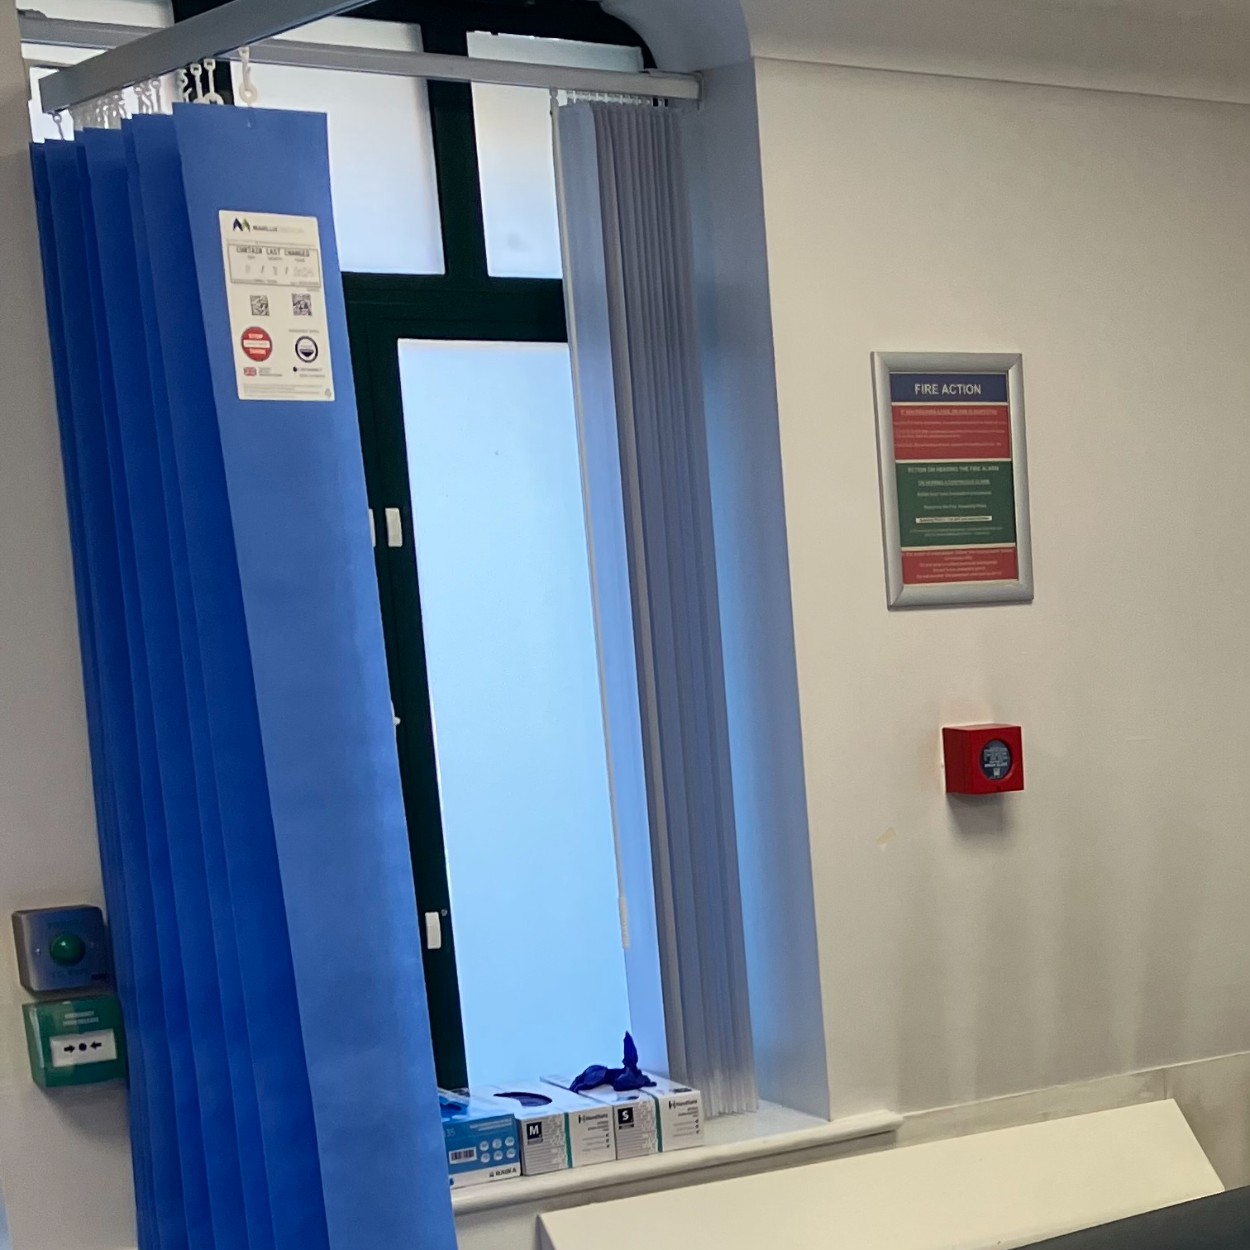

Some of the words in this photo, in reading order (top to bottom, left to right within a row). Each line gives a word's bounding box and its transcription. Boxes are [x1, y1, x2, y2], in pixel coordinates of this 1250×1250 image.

[266, 247, 281, 256] LAST
[914, 383, 939, 395] FIRE
[941, 383, 982, 395] ACTION
[622, 1110, 629, 1120] S
[529, 1124, 539, 1136] M
